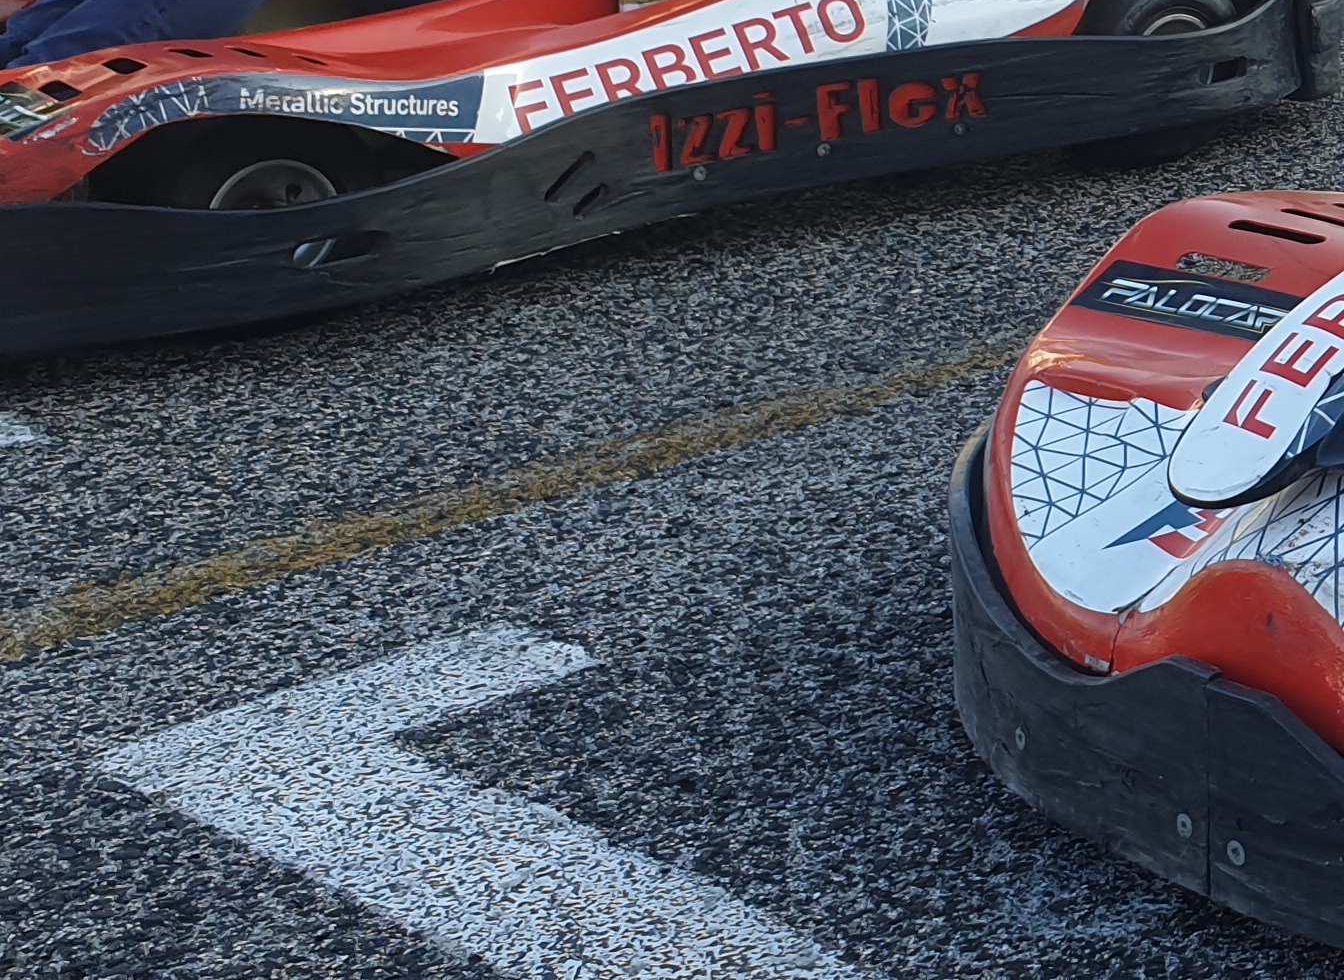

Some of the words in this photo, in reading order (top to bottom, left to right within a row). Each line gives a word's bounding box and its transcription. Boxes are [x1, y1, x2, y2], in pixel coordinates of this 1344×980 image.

[239, 88, 344, 115] Metallic
[350, 91, 460, 118] Structures
[1101, 278, 1290, 331] PALOCAR
